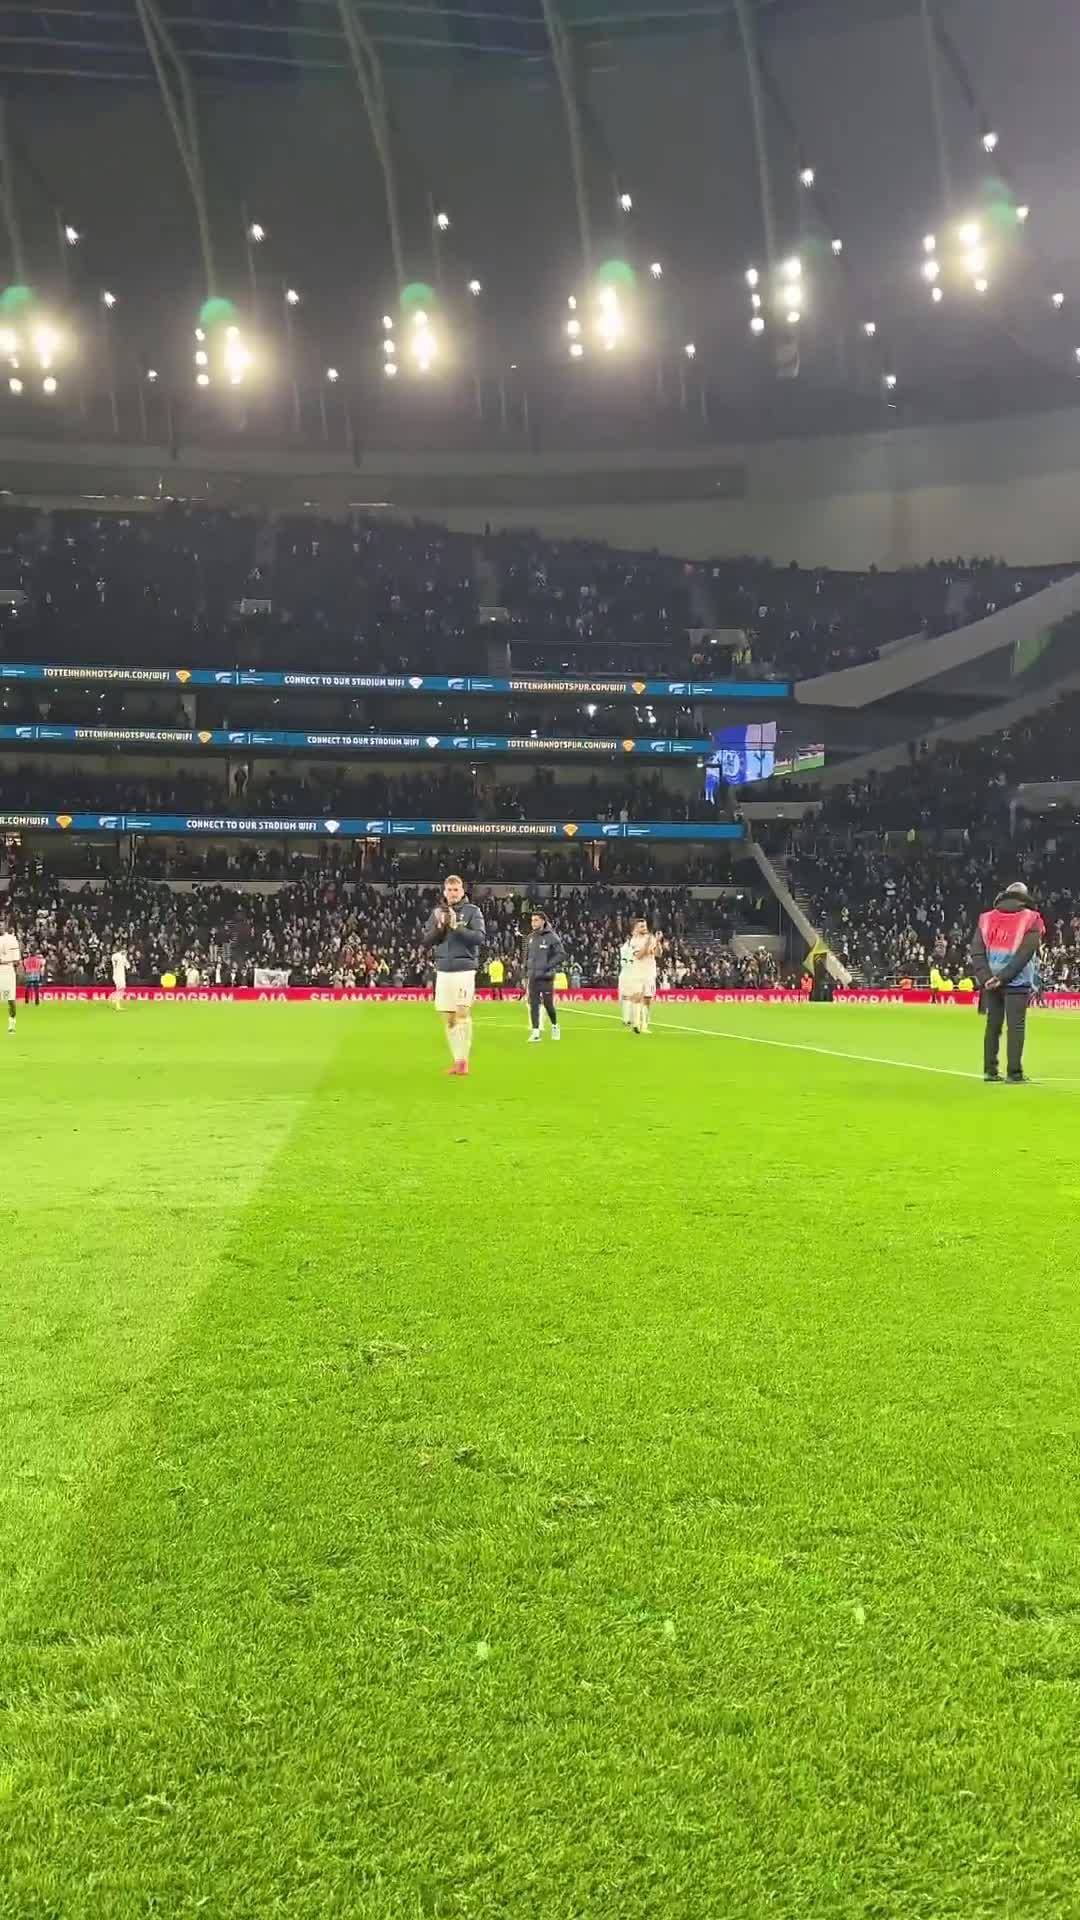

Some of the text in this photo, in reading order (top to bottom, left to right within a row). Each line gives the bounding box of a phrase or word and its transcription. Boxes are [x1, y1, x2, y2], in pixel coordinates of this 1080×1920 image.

[284, 676, 405, 687] CONNECT TO OUR STADIUM WIFI
[306, 736, 420, 746] CONNECT TO OUR STADIUM WIFI
[186, 820, 317, 832] CONNECT TO OUR STADIUM WIFI
